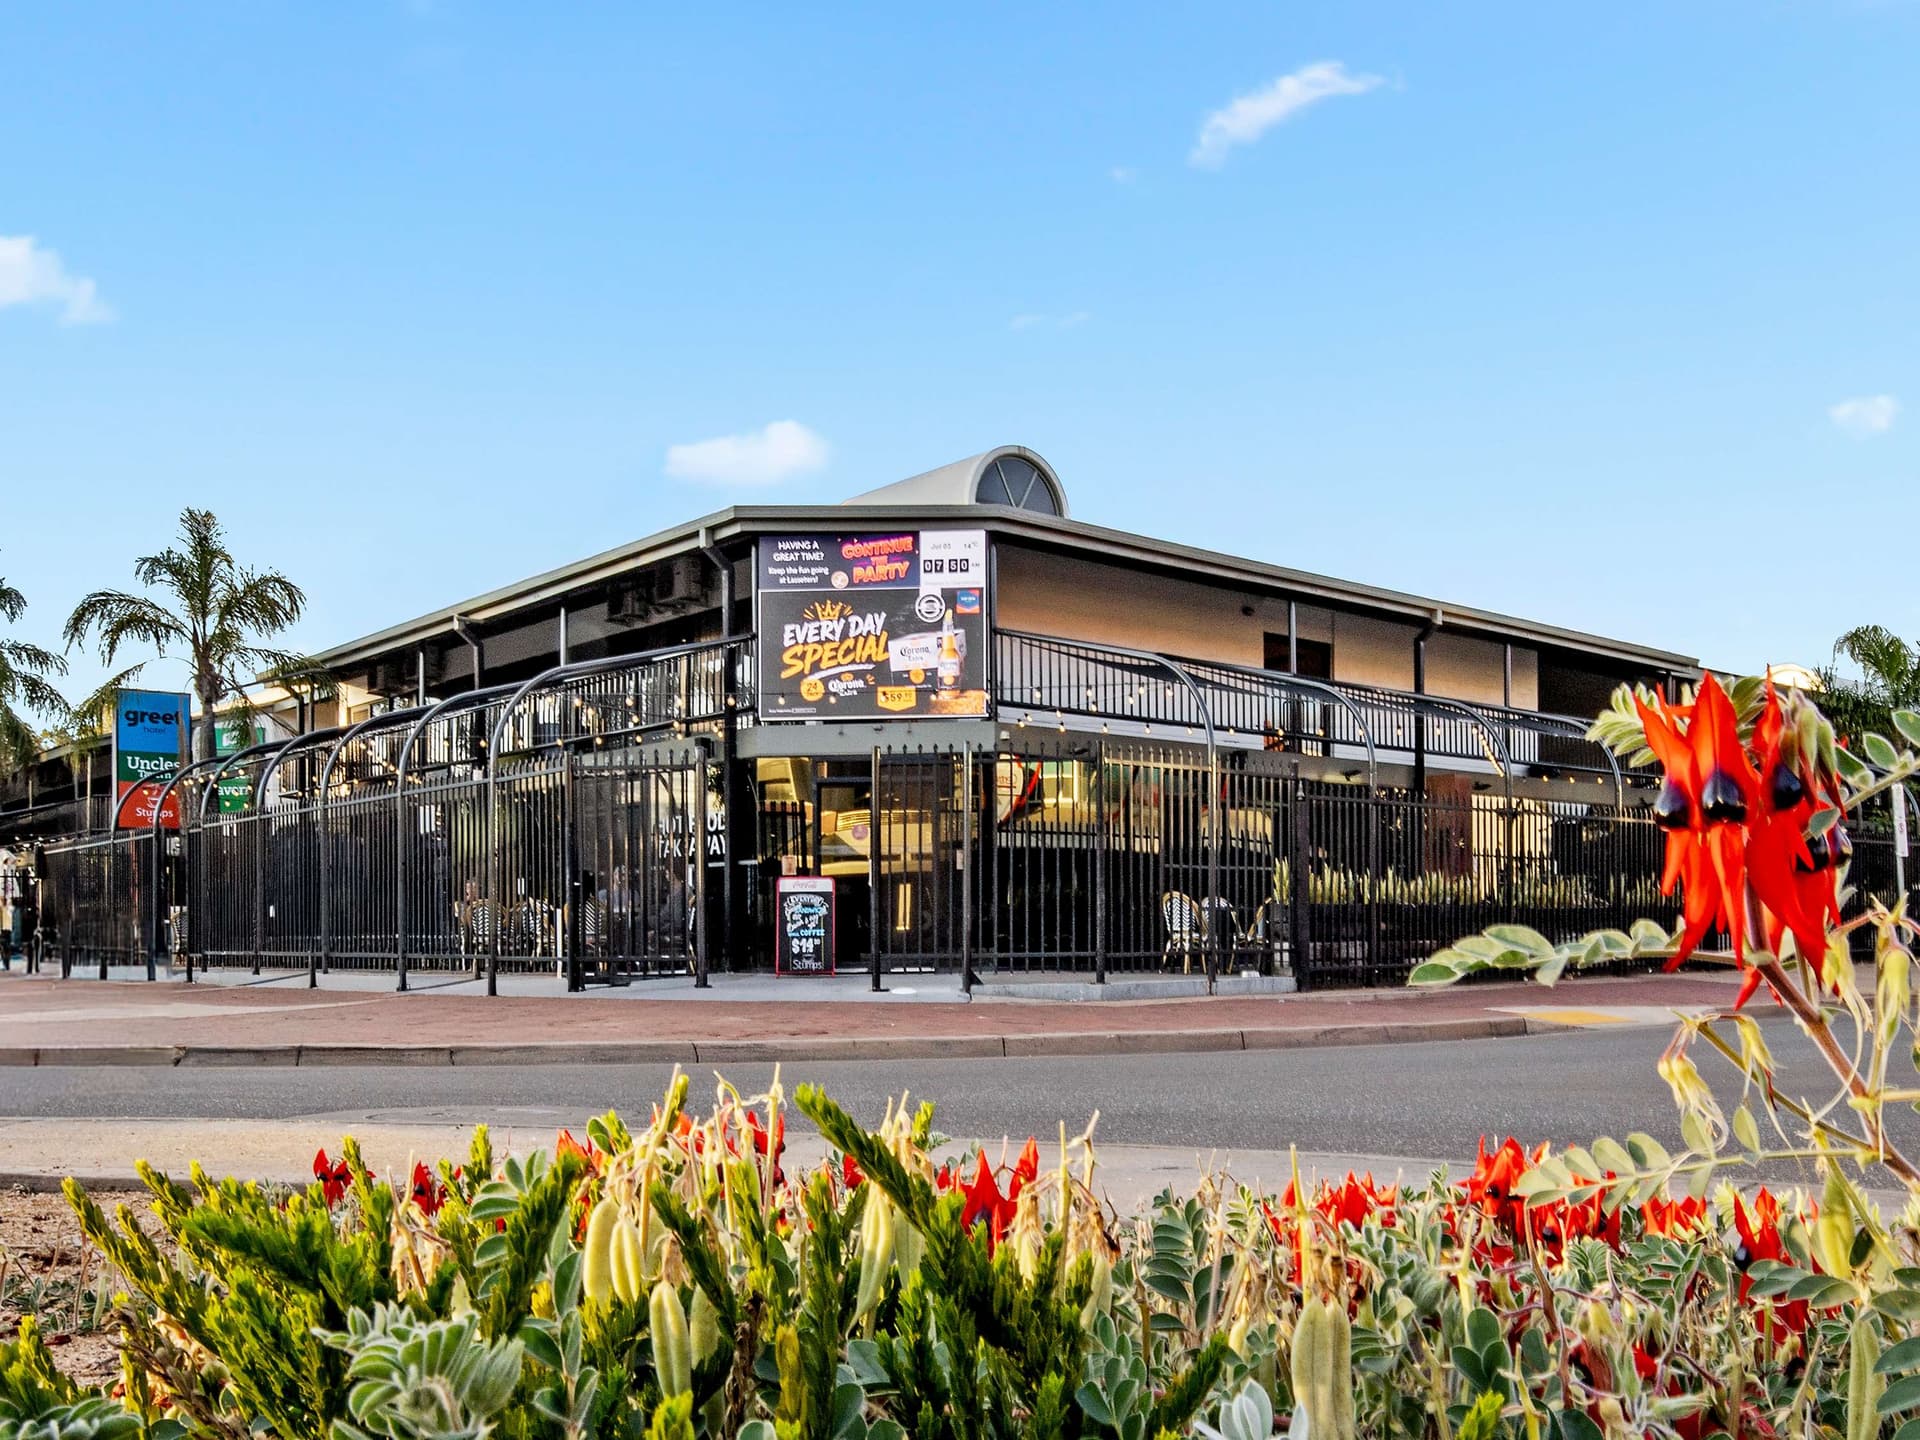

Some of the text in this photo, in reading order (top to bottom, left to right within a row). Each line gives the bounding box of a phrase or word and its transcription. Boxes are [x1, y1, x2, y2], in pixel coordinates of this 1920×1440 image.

[777, 540, 820, 550] HAVING A
[842, 536, 914, 560] CONTINUE
[772, 551, 825, 562] GREAT TIME?
[768, 565, 830, 576] Keep the fun going
[853, 560, 910, 584] PARTY
[783, 611, 887, 648] EVERY DAY
[780, 630, 890, 680] SPECIAL
[900, 645, 930, 657] Corona
[806, 682, 818, 692] 24
[828, 679, 866, 693] Corona
[143, 725, 166, 734] hotel
[135, 807, 174, 819] Stups
[800, 928, 825, 937] COFFEE
[792, 959, 823, 971] Stumps
